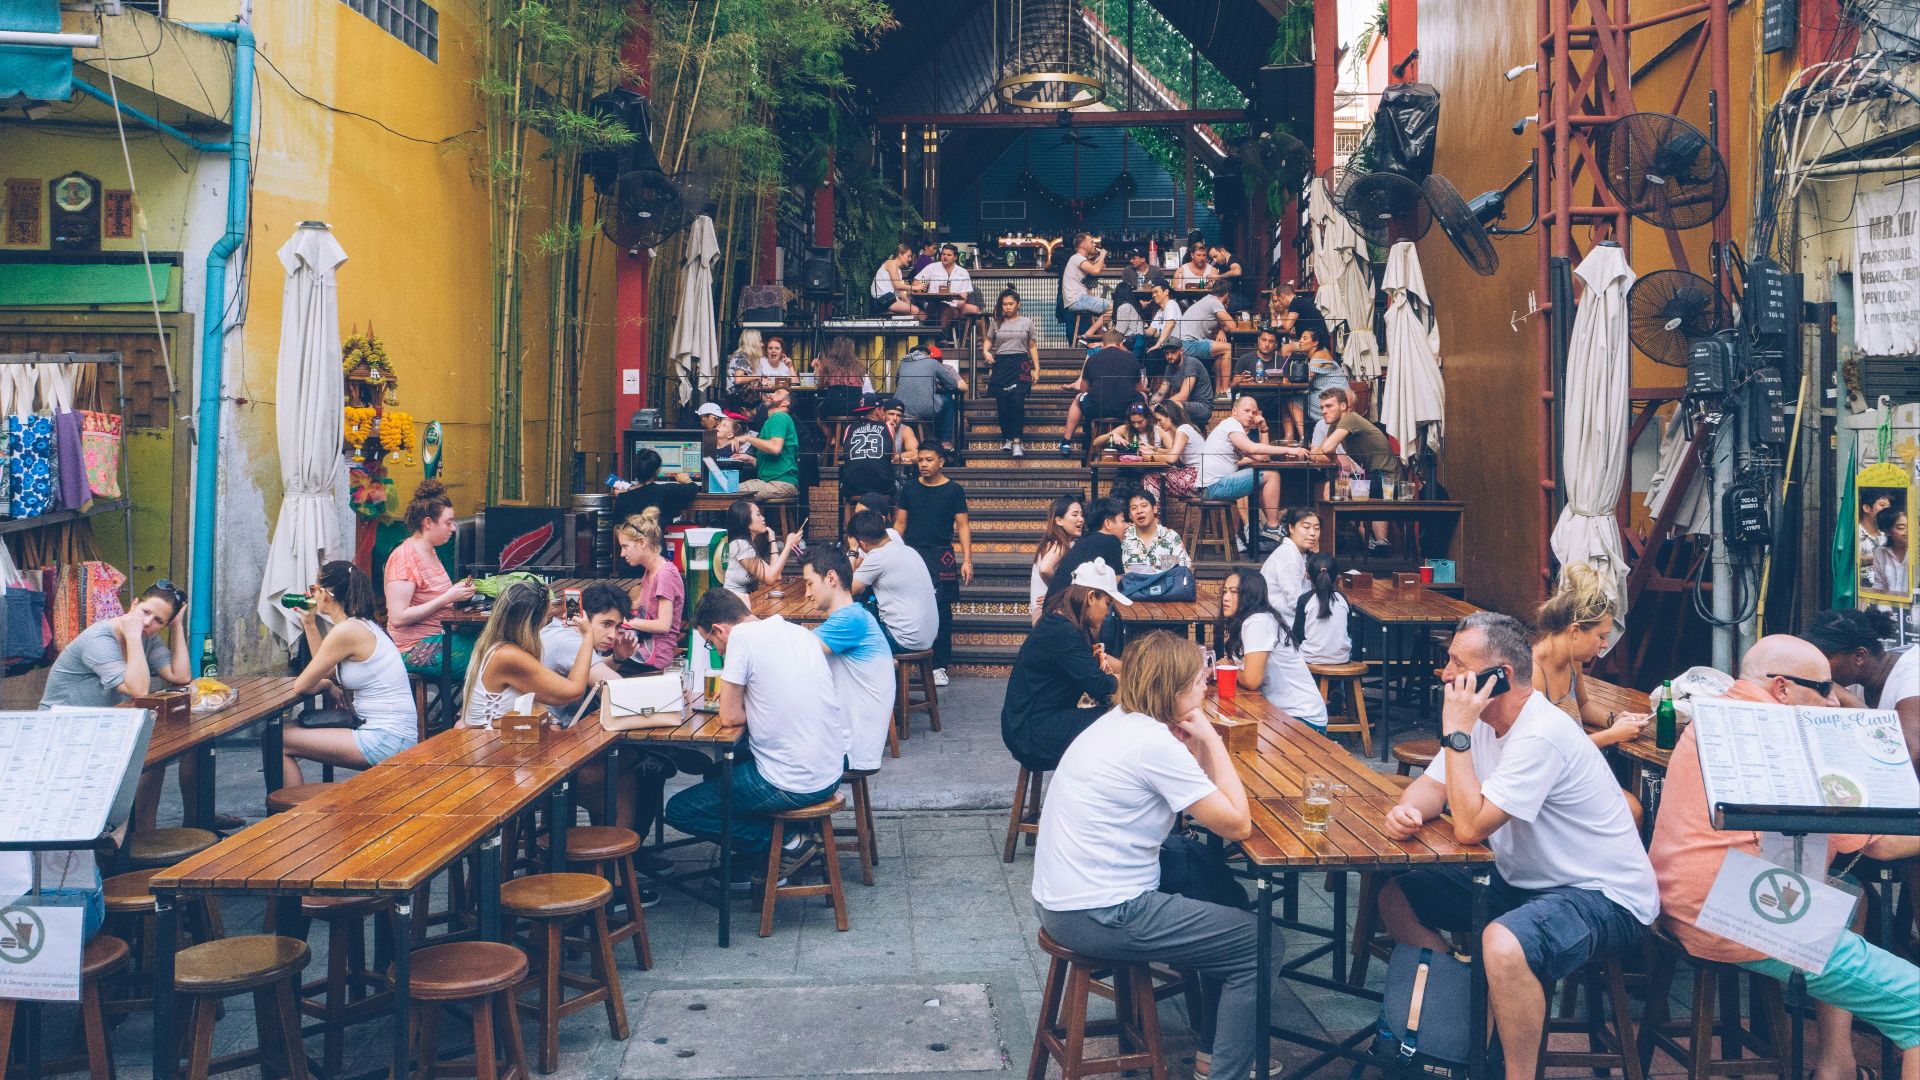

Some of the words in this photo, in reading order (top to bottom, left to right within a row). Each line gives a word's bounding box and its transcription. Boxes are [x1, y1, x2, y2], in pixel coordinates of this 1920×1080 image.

[850, 434, 884, 460] 23
[1803, 711, 1839, 727] Soup
[1849, 712, 1897, 727] Curry
